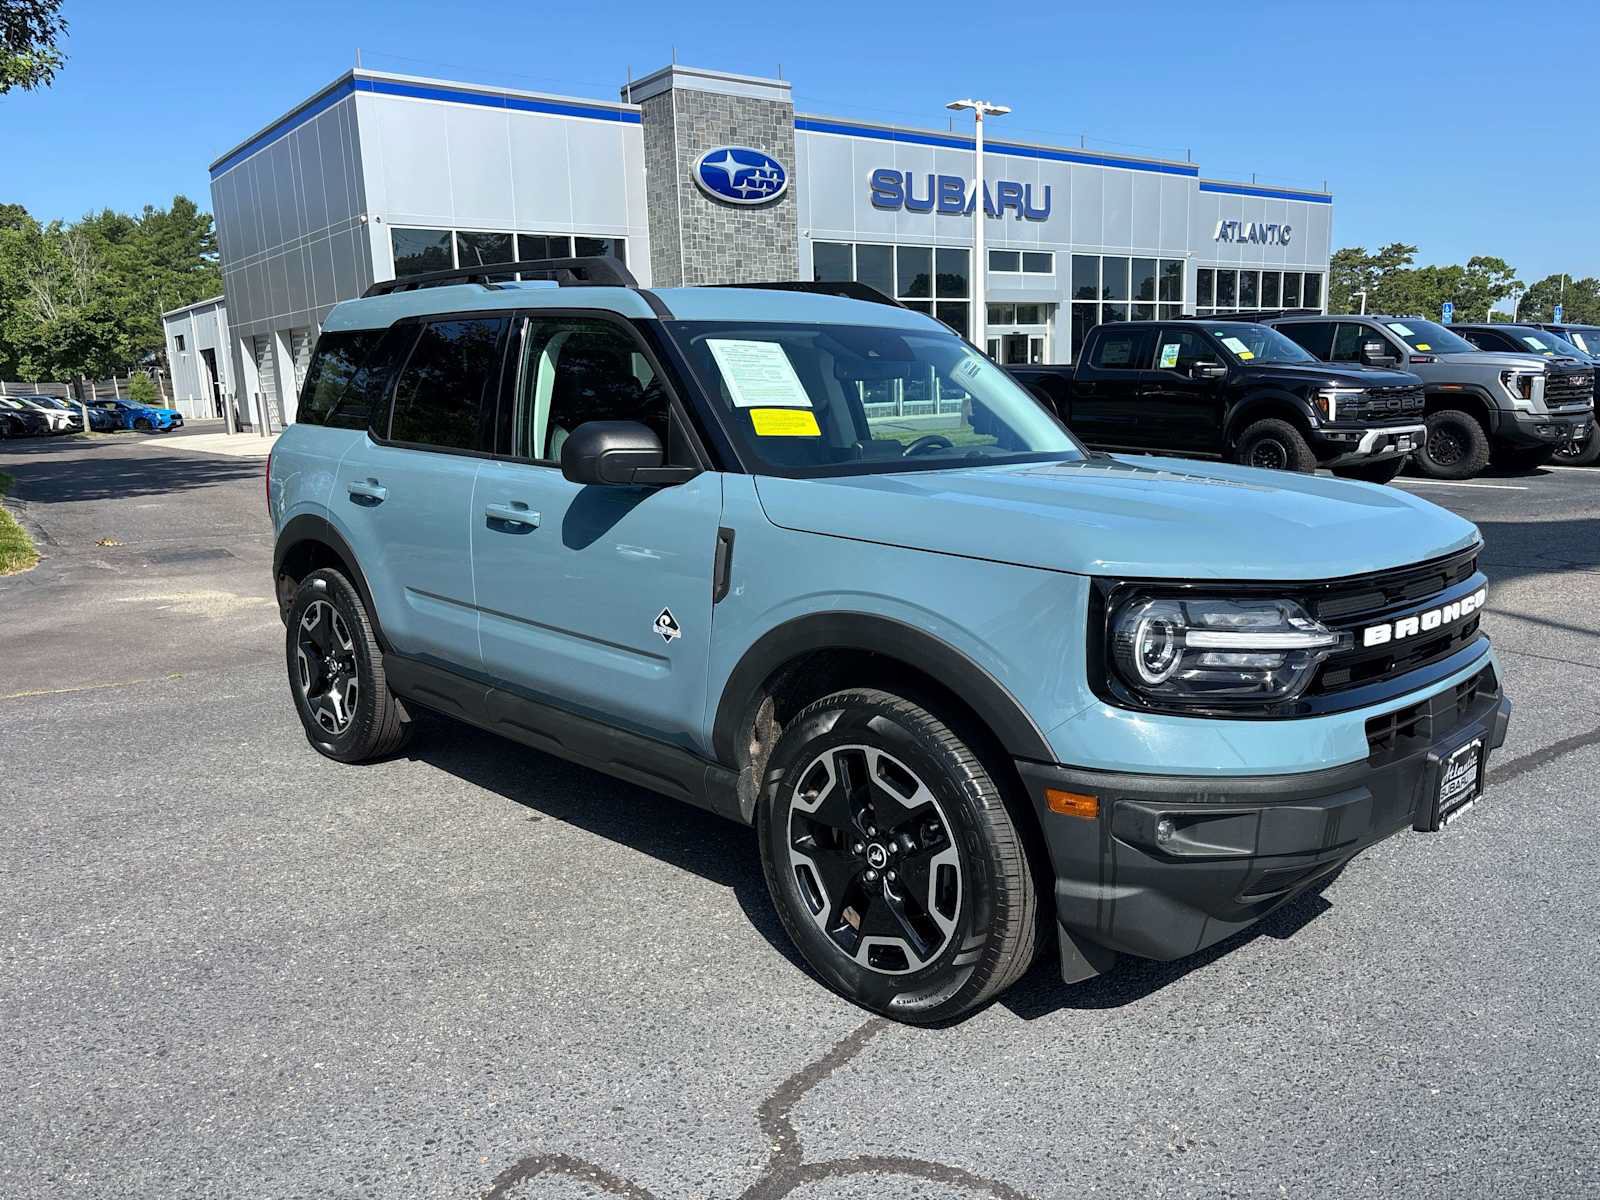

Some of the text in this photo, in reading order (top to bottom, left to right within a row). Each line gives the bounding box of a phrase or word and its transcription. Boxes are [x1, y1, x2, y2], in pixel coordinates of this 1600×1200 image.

[870, 168, 1051, 222] SUBARU
[1213, 220, 1292, 246] ATLANTIC
[1367, 398, 1424, 410] FORD
[1363, 588, 1486, 647] BRONCO
